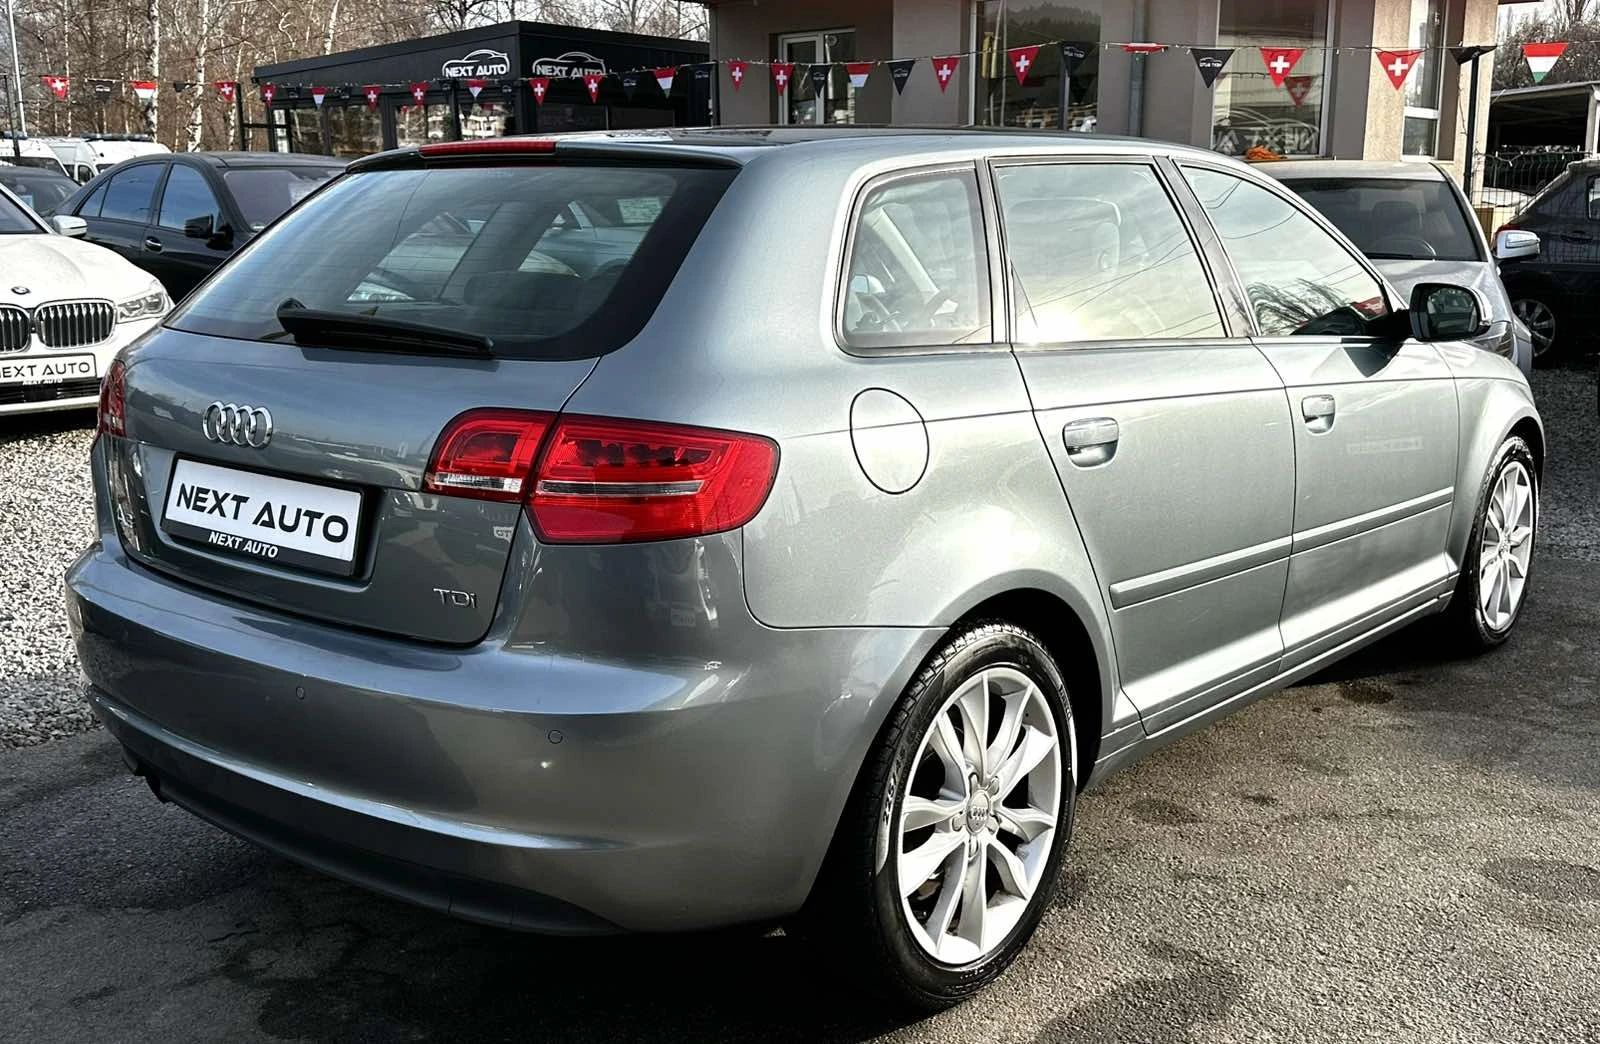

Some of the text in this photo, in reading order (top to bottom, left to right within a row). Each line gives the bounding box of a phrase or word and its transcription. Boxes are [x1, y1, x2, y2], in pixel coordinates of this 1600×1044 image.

[445, 63, 507, 78] NEXT AUTO
[536, 64, 568, 77] NEXT
[0, 361, 90, 379] EXT AUTO
[176, 482, 349, 543] NEXT AUTO
[208, 531, 279, 558] NEXT AUTO
